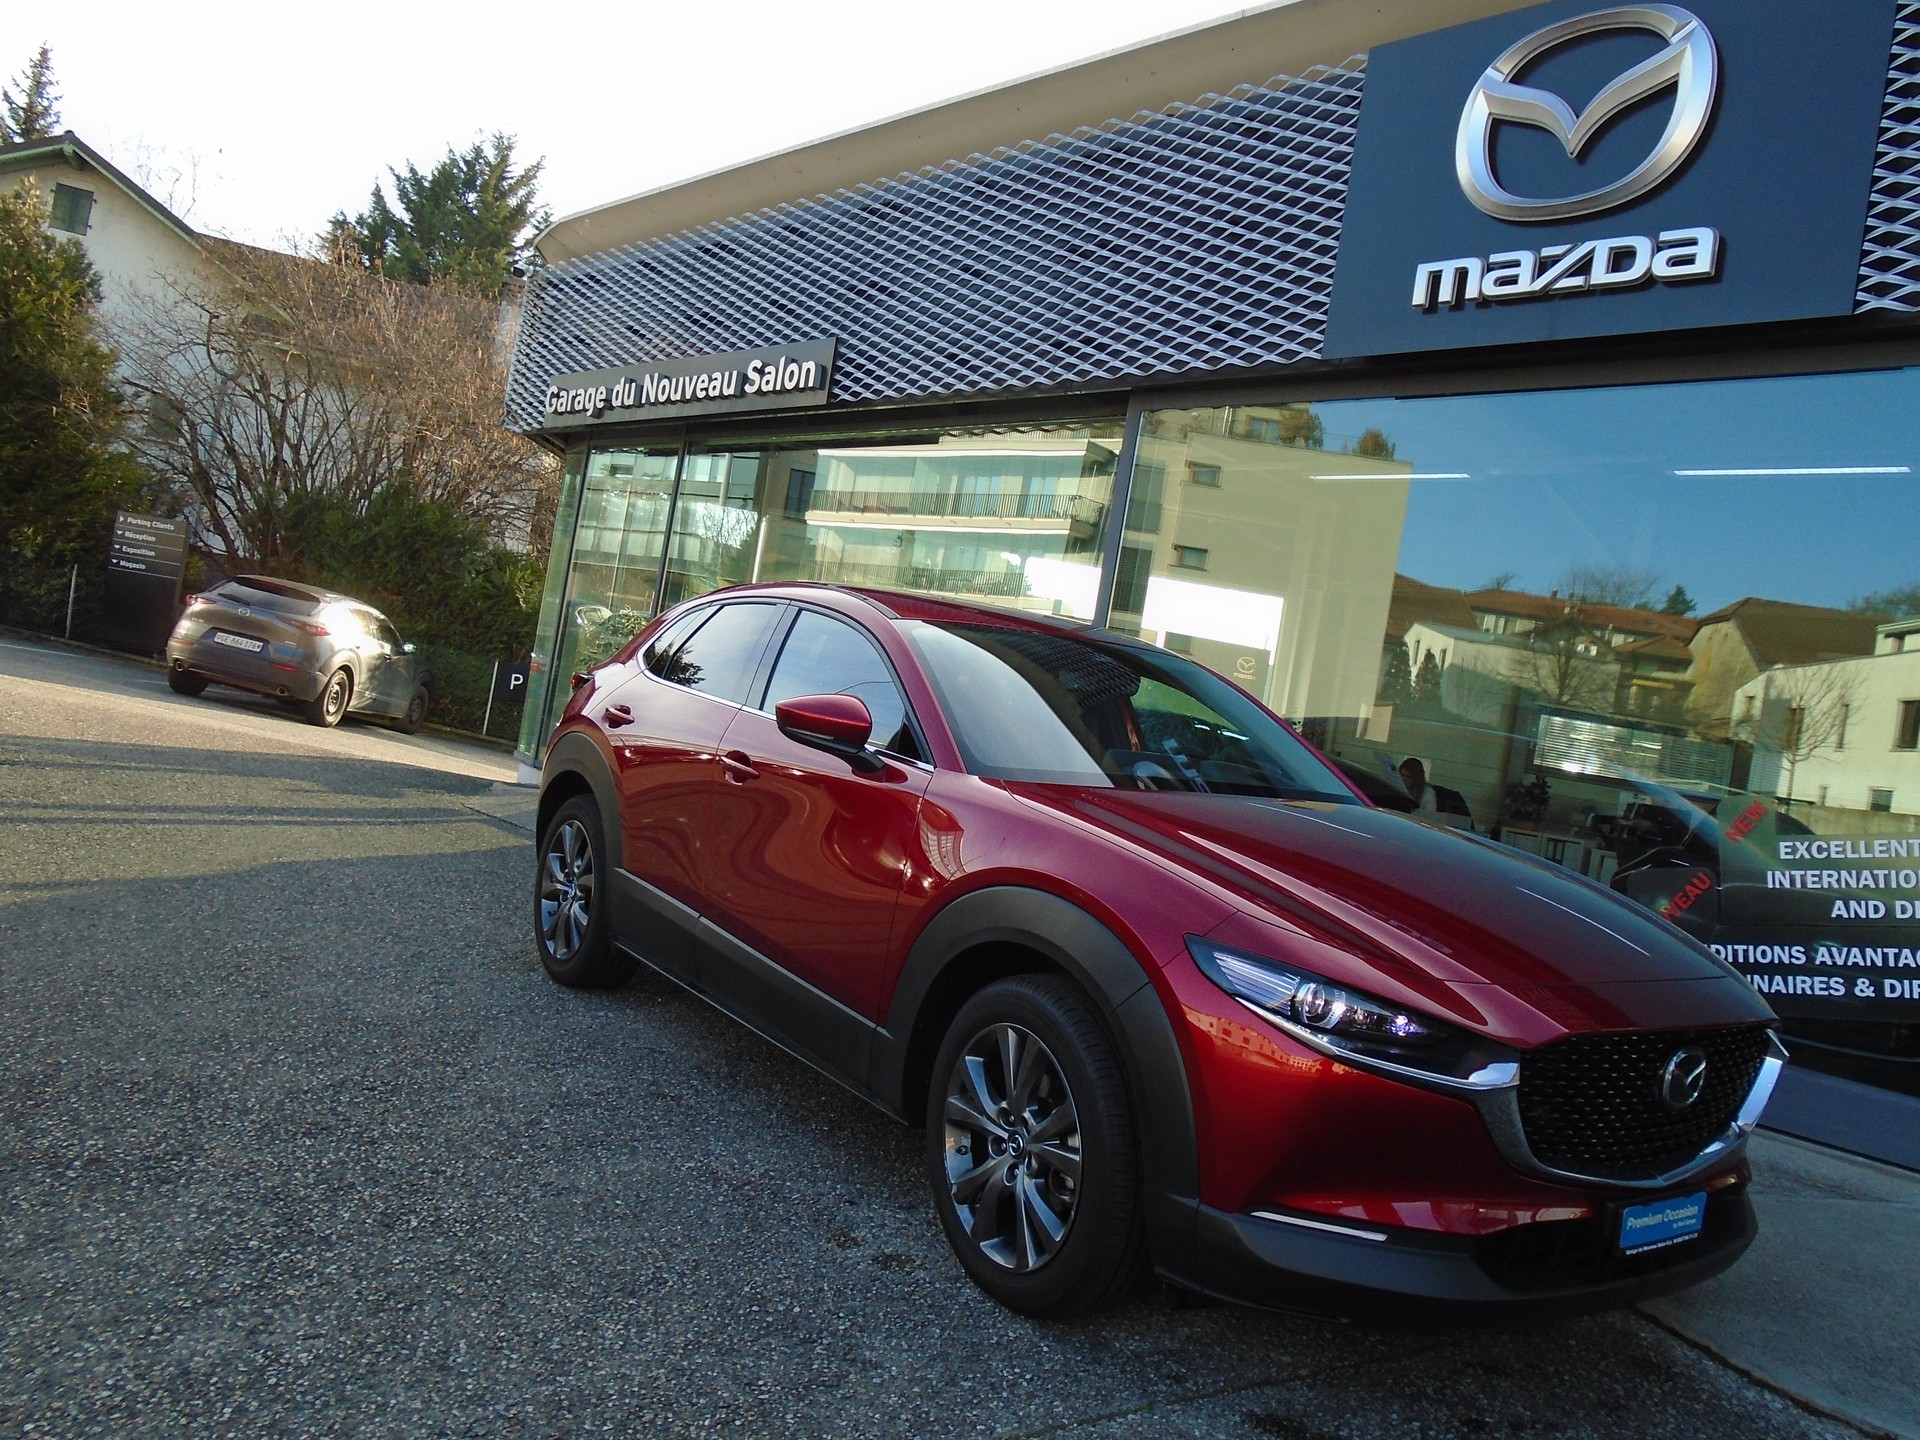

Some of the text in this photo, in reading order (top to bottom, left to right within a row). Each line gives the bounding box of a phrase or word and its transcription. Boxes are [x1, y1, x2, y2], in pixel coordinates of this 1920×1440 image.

[546, 355, 817, 417] Garage du Nouveau Salon
[127, 516, 175, 531] Parking Clients
[124, 530, 156, 542] Réception
[122, 545, 156, 557] Exposition
[119, 560, 146, 570] Magasin
[510, 674, 524, 690] P
[1724, 800, 1766, 843] NEW
[1767, 869, 1920, 889] INTERNATIO
[1831, 900, 1886, 919] AND
[1704, 944, 1807, 965] DITIONS
[1815, 947, 1920, 968] AVANTA
[1854, 978, 1876, 997] &
[1627, 1213, 1663, 1230] Premium
[1664, 1205, 1699, 1222] Occasion
